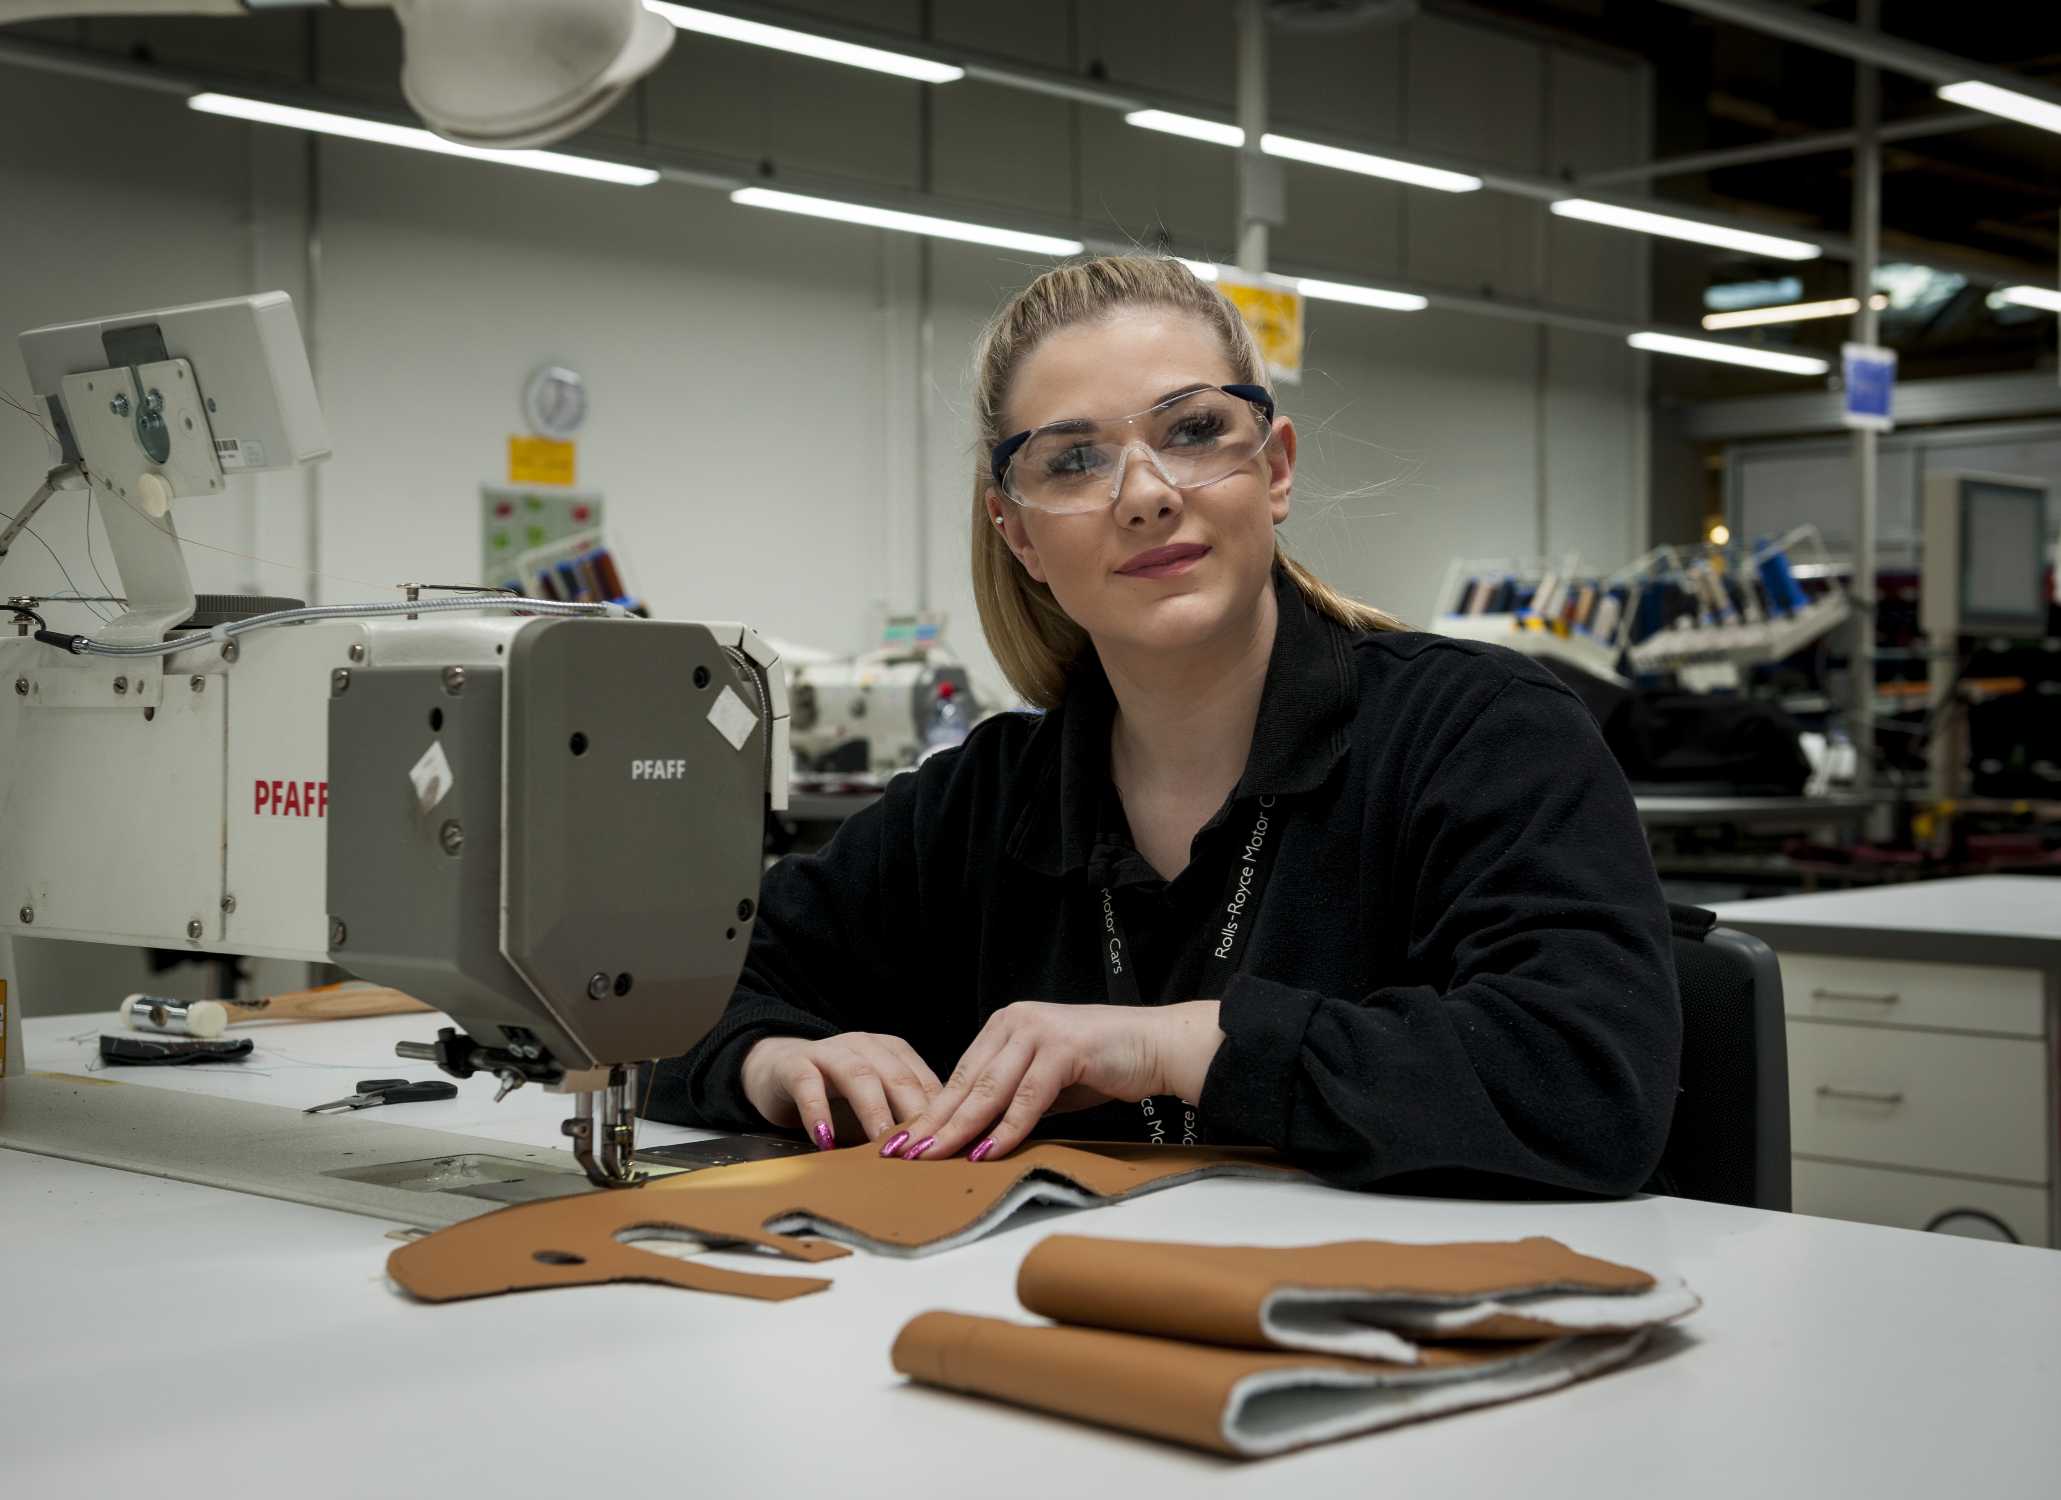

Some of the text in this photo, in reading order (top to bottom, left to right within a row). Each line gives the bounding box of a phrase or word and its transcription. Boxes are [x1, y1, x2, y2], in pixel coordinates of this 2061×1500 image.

[255, 780, 328, 817] PFAFF
[632, 759, 686, 780] PFAFF
[1214, 866, 1254, 959] Rolls-Royce
[1242, 811, 1270, 862] Motor
[1101, 887, 1123, 975] Motor Cars
